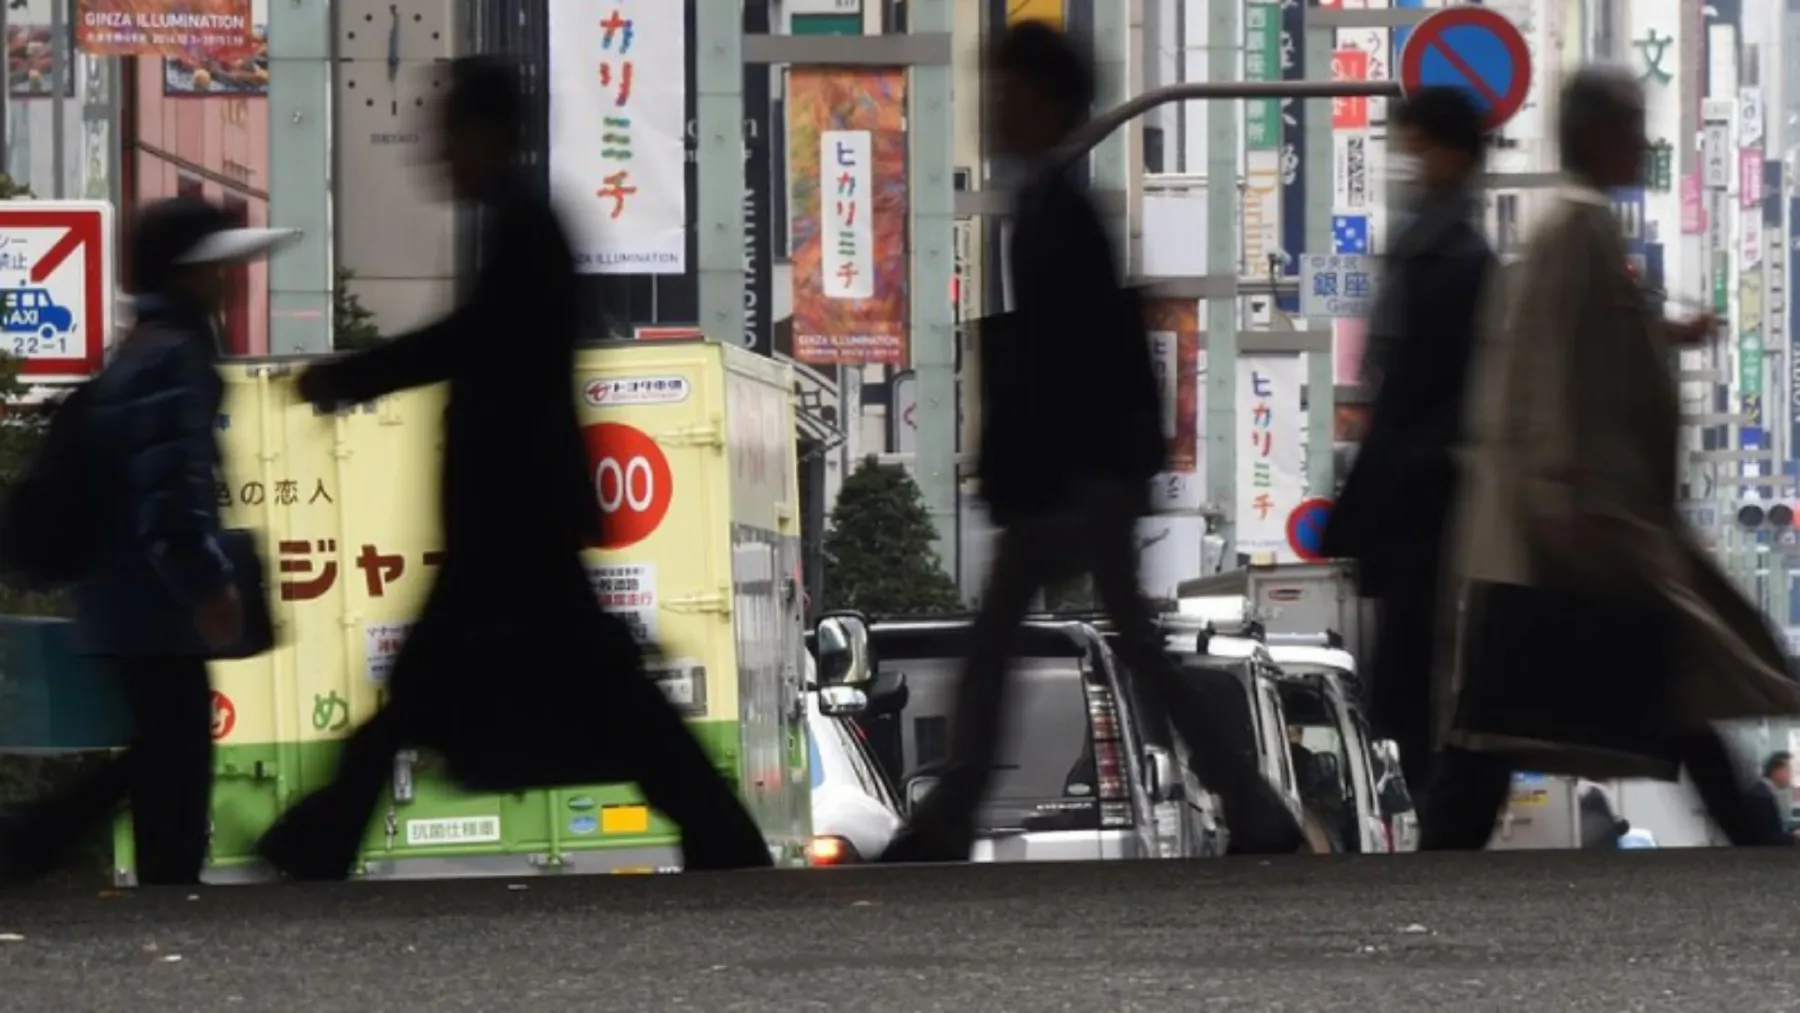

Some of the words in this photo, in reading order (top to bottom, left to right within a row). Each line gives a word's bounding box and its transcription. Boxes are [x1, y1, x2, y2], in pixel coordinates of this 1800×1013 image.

[84, 12, 132, 27] GINZA
[136, 13, 244, 29] ILLUMINATION
[835, 141, 858, 289] ヒカリミチ
[596, 252, 679, 265] ILLUMINATION
[1313, 272, 1369, 297] 銀座
[13, 336, 67, 354] 22-1
[1251, 370, 1274, 521] ヒカリミチ
